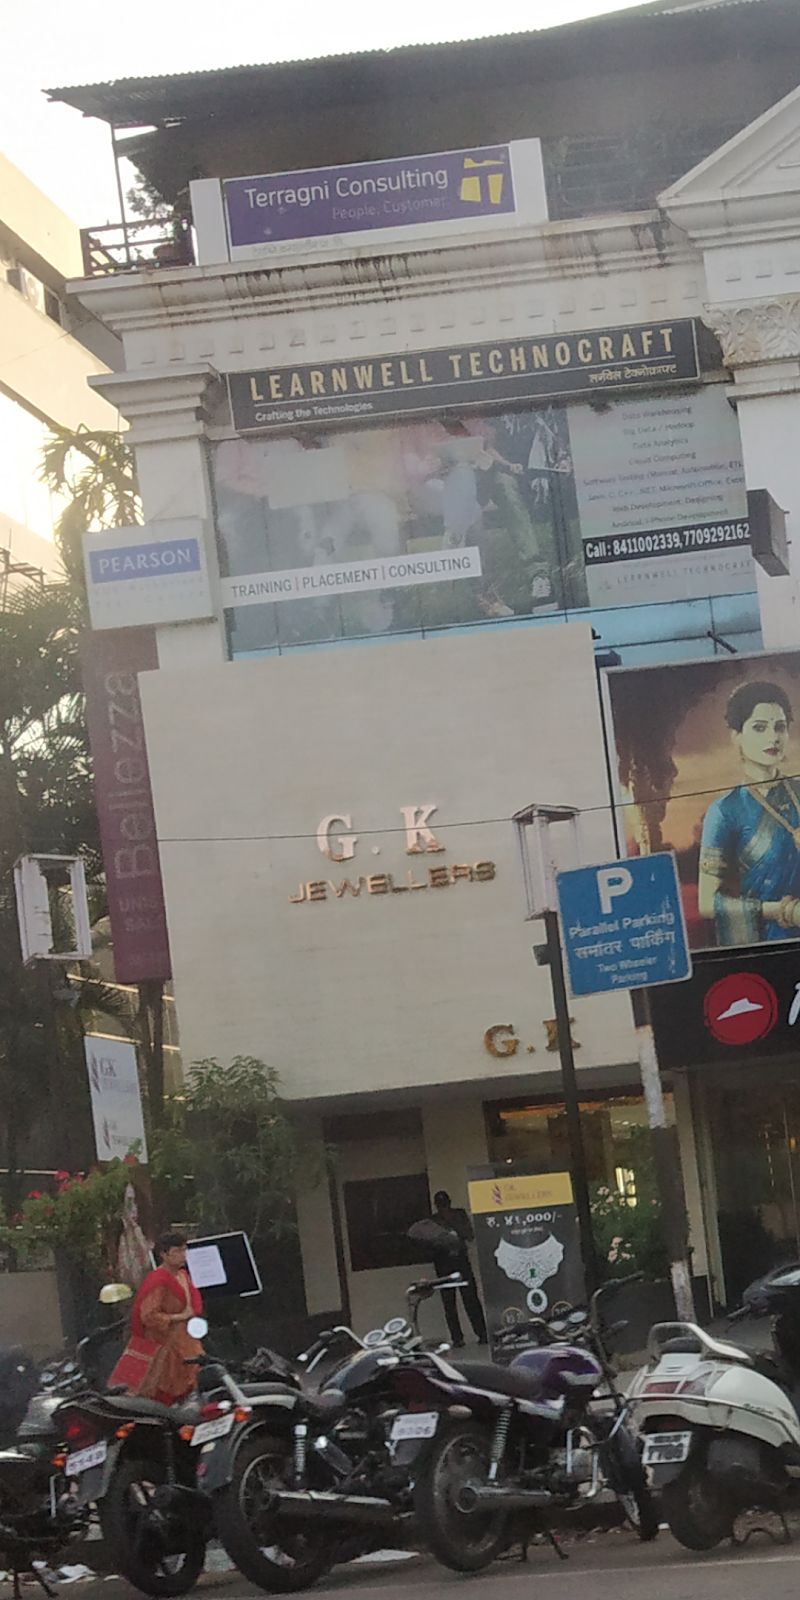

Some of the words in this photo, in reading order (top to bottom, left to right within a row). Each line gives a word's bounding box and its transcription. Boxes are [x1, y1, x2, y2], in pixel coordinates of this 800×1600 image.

[244, 179, 330, 209] Terragni
[335, 168, 449, 199] Consulting
[250, 358, 434, 401] LEARNWELL
[449, 327, 673, 379] TECHNOCRAFT
[255, 406, 294, 423] Crafting
[296, 406, 312, 418] the
[314, 402, 373, 416] Technologies
[99, 548, 192, 575] PEARSON
[231, 579, 292, 598] TRAINING
[302, 567, 378, 589] PLACEMENT
[389, 556, 472, 578] CONSULTING
[104, 670, 154, 880] Bellezza
[288, 860, 497, 904] JEWELLERS
[596, 867, 633, 915] P
[569, 920, 620, 939] Parallel
[621, 912, 674, 930] Parking
[597, 962, 617, 973] Two
[611, 971, 648, 984] Parking
